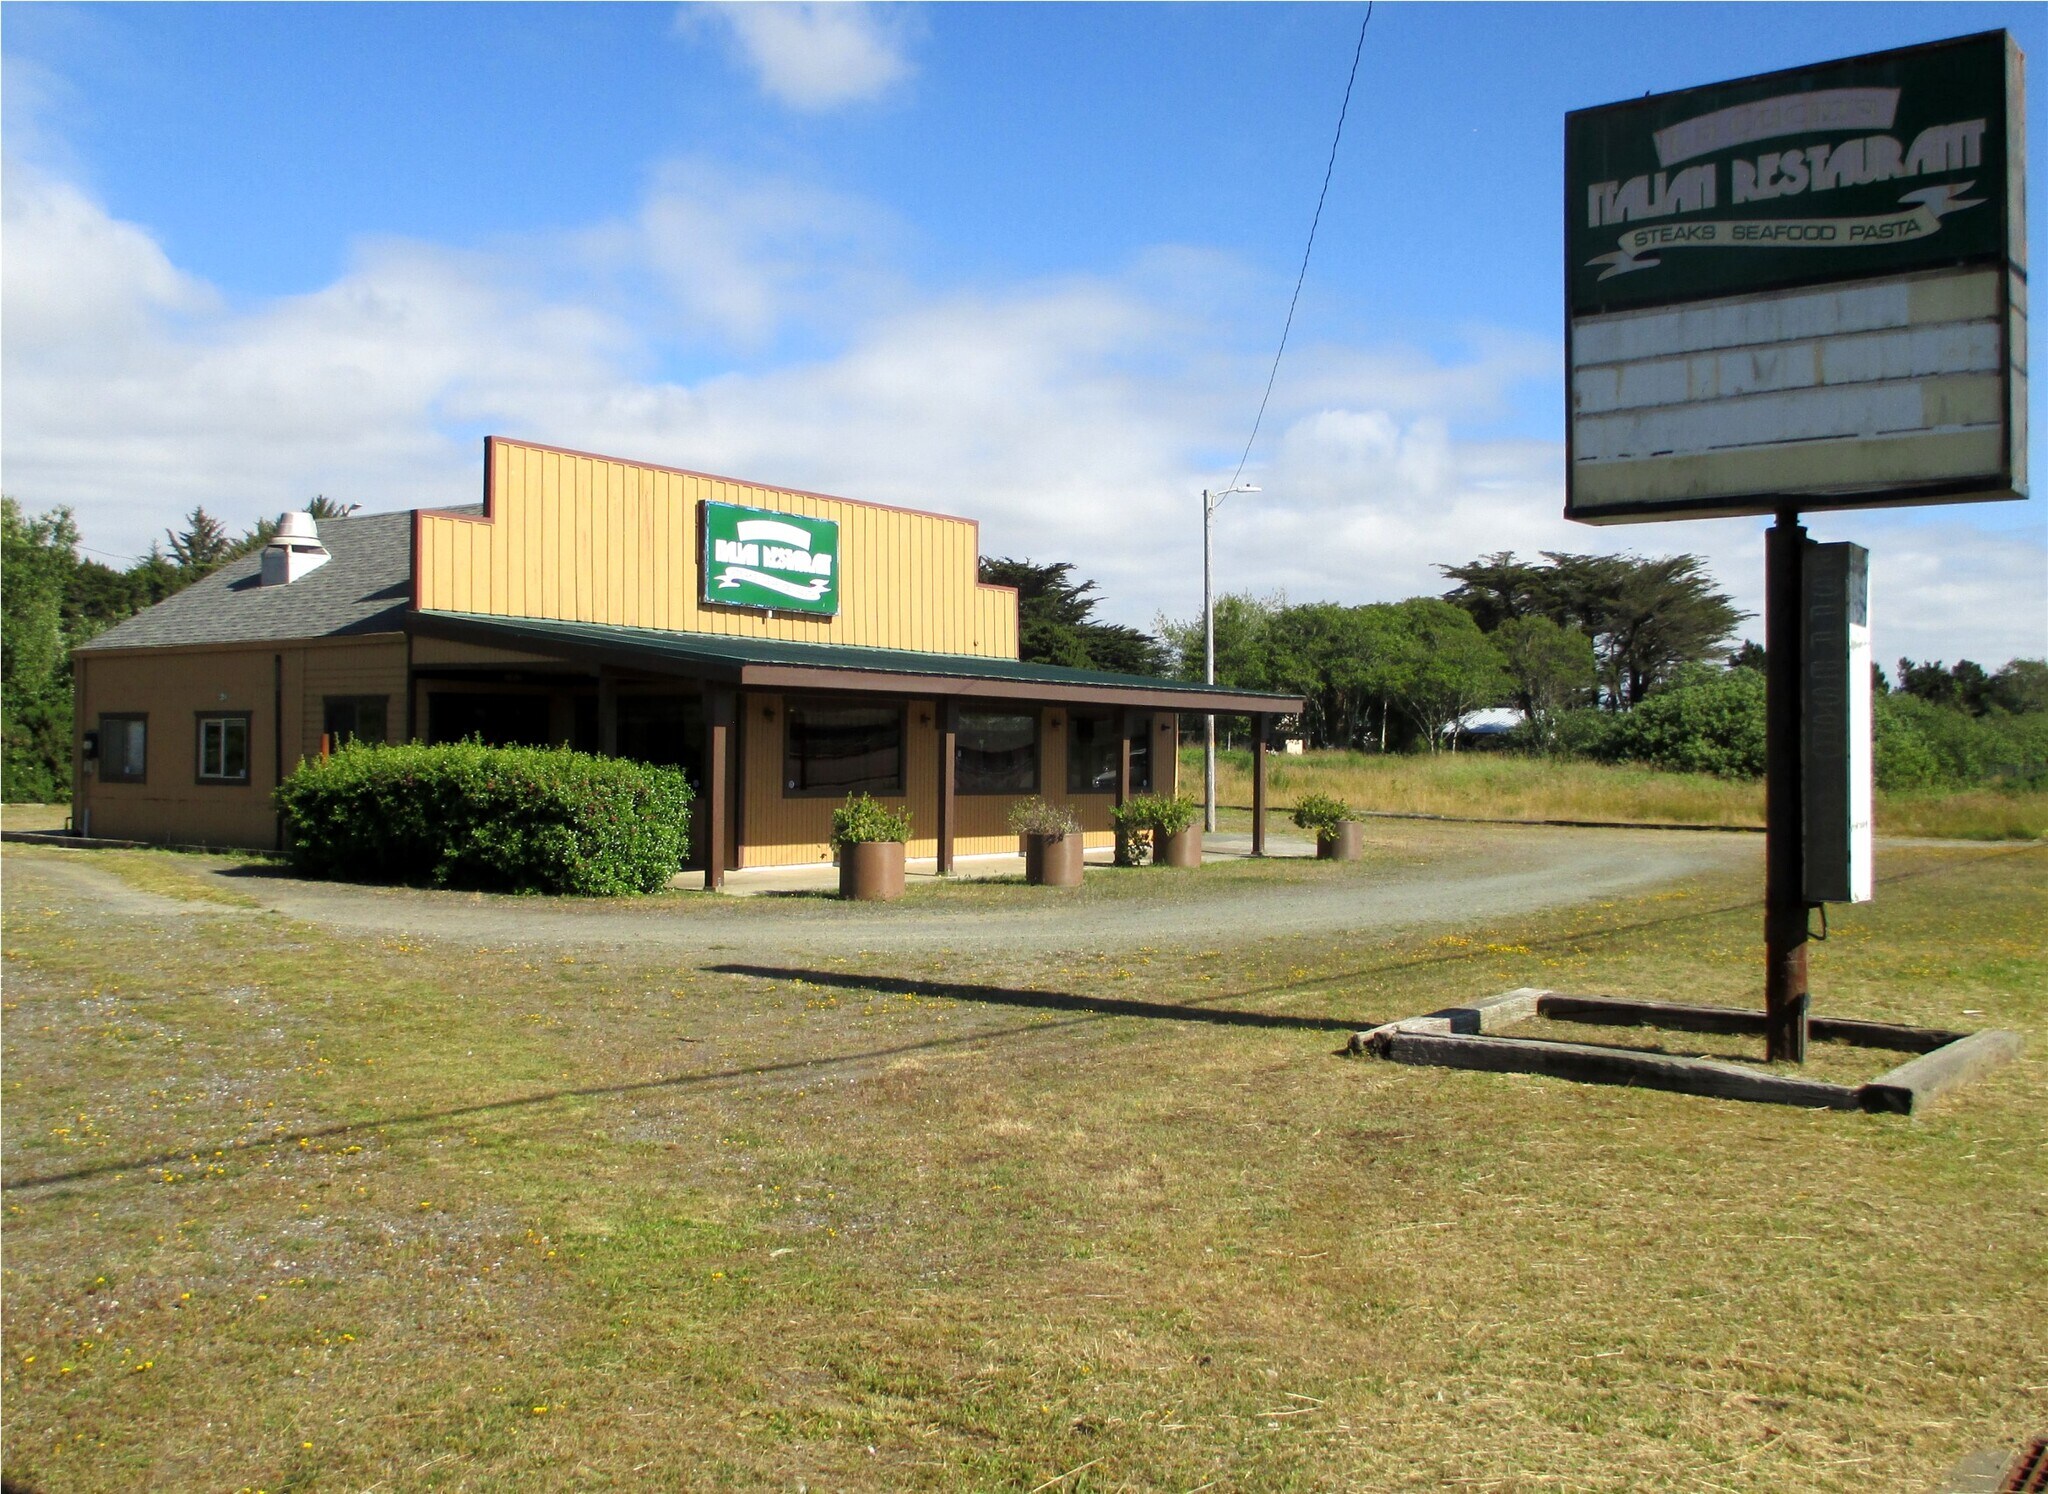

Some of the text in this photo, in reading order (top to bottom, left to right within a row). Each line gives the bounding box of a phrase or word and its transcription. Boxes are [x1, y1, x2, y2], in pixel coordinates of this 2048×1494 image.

[1587, 162, 1717, 229] ITALIAN
[1731, 117, 1987, 205] RESTAURANT
[1633, 217, 1923, 248] STEAKS SEAFOOD PASTA
